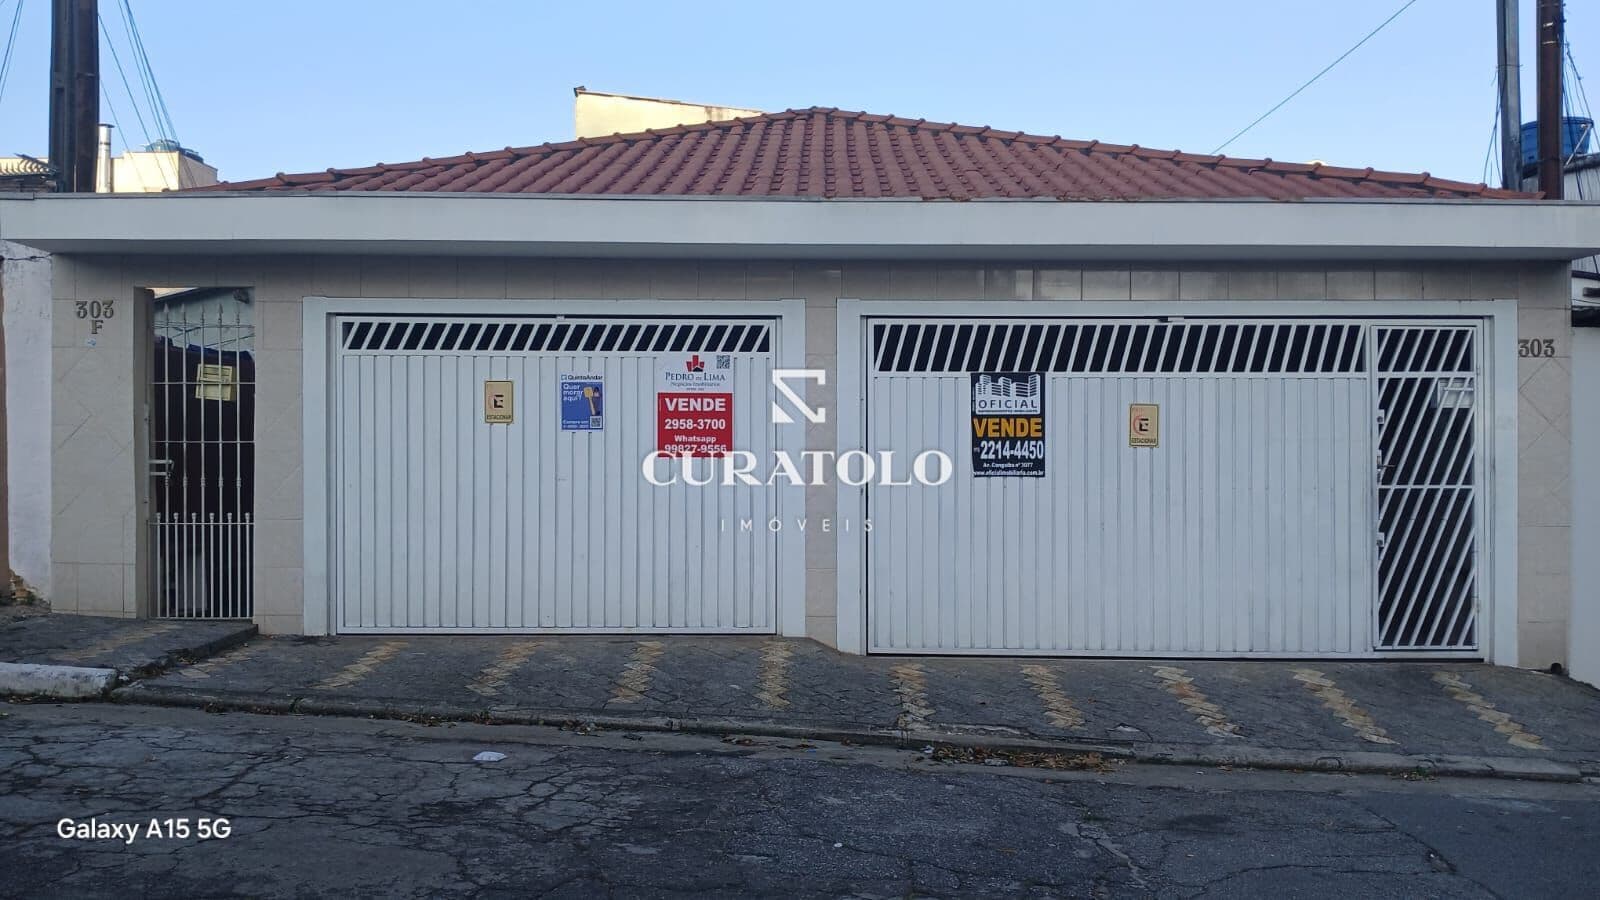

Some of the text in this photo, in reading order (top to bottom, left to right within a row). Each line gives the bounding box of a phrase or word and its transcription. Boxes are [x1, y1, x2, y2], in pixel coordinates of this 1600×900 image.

[76, 300, 114, 319] 303
[91, 320, 104, 335] F
[1518, 338, 1555, 358] 303
[665, 372, 694, 381] PEDRO
[704, 372, 726, 381] LIMA
[665, 398, 726, 411] VENDE
[978, 399, 1038, 409] OFICIAL
[664, 418, 726, 430] 2958-3700
[973, 418, 1042, 437] VENDE
[674, 435, 717, 444] Whatsapp
[664, 444, 727, 455] 99827-9556
[980, 440, 1044, 459] 2214-4450
